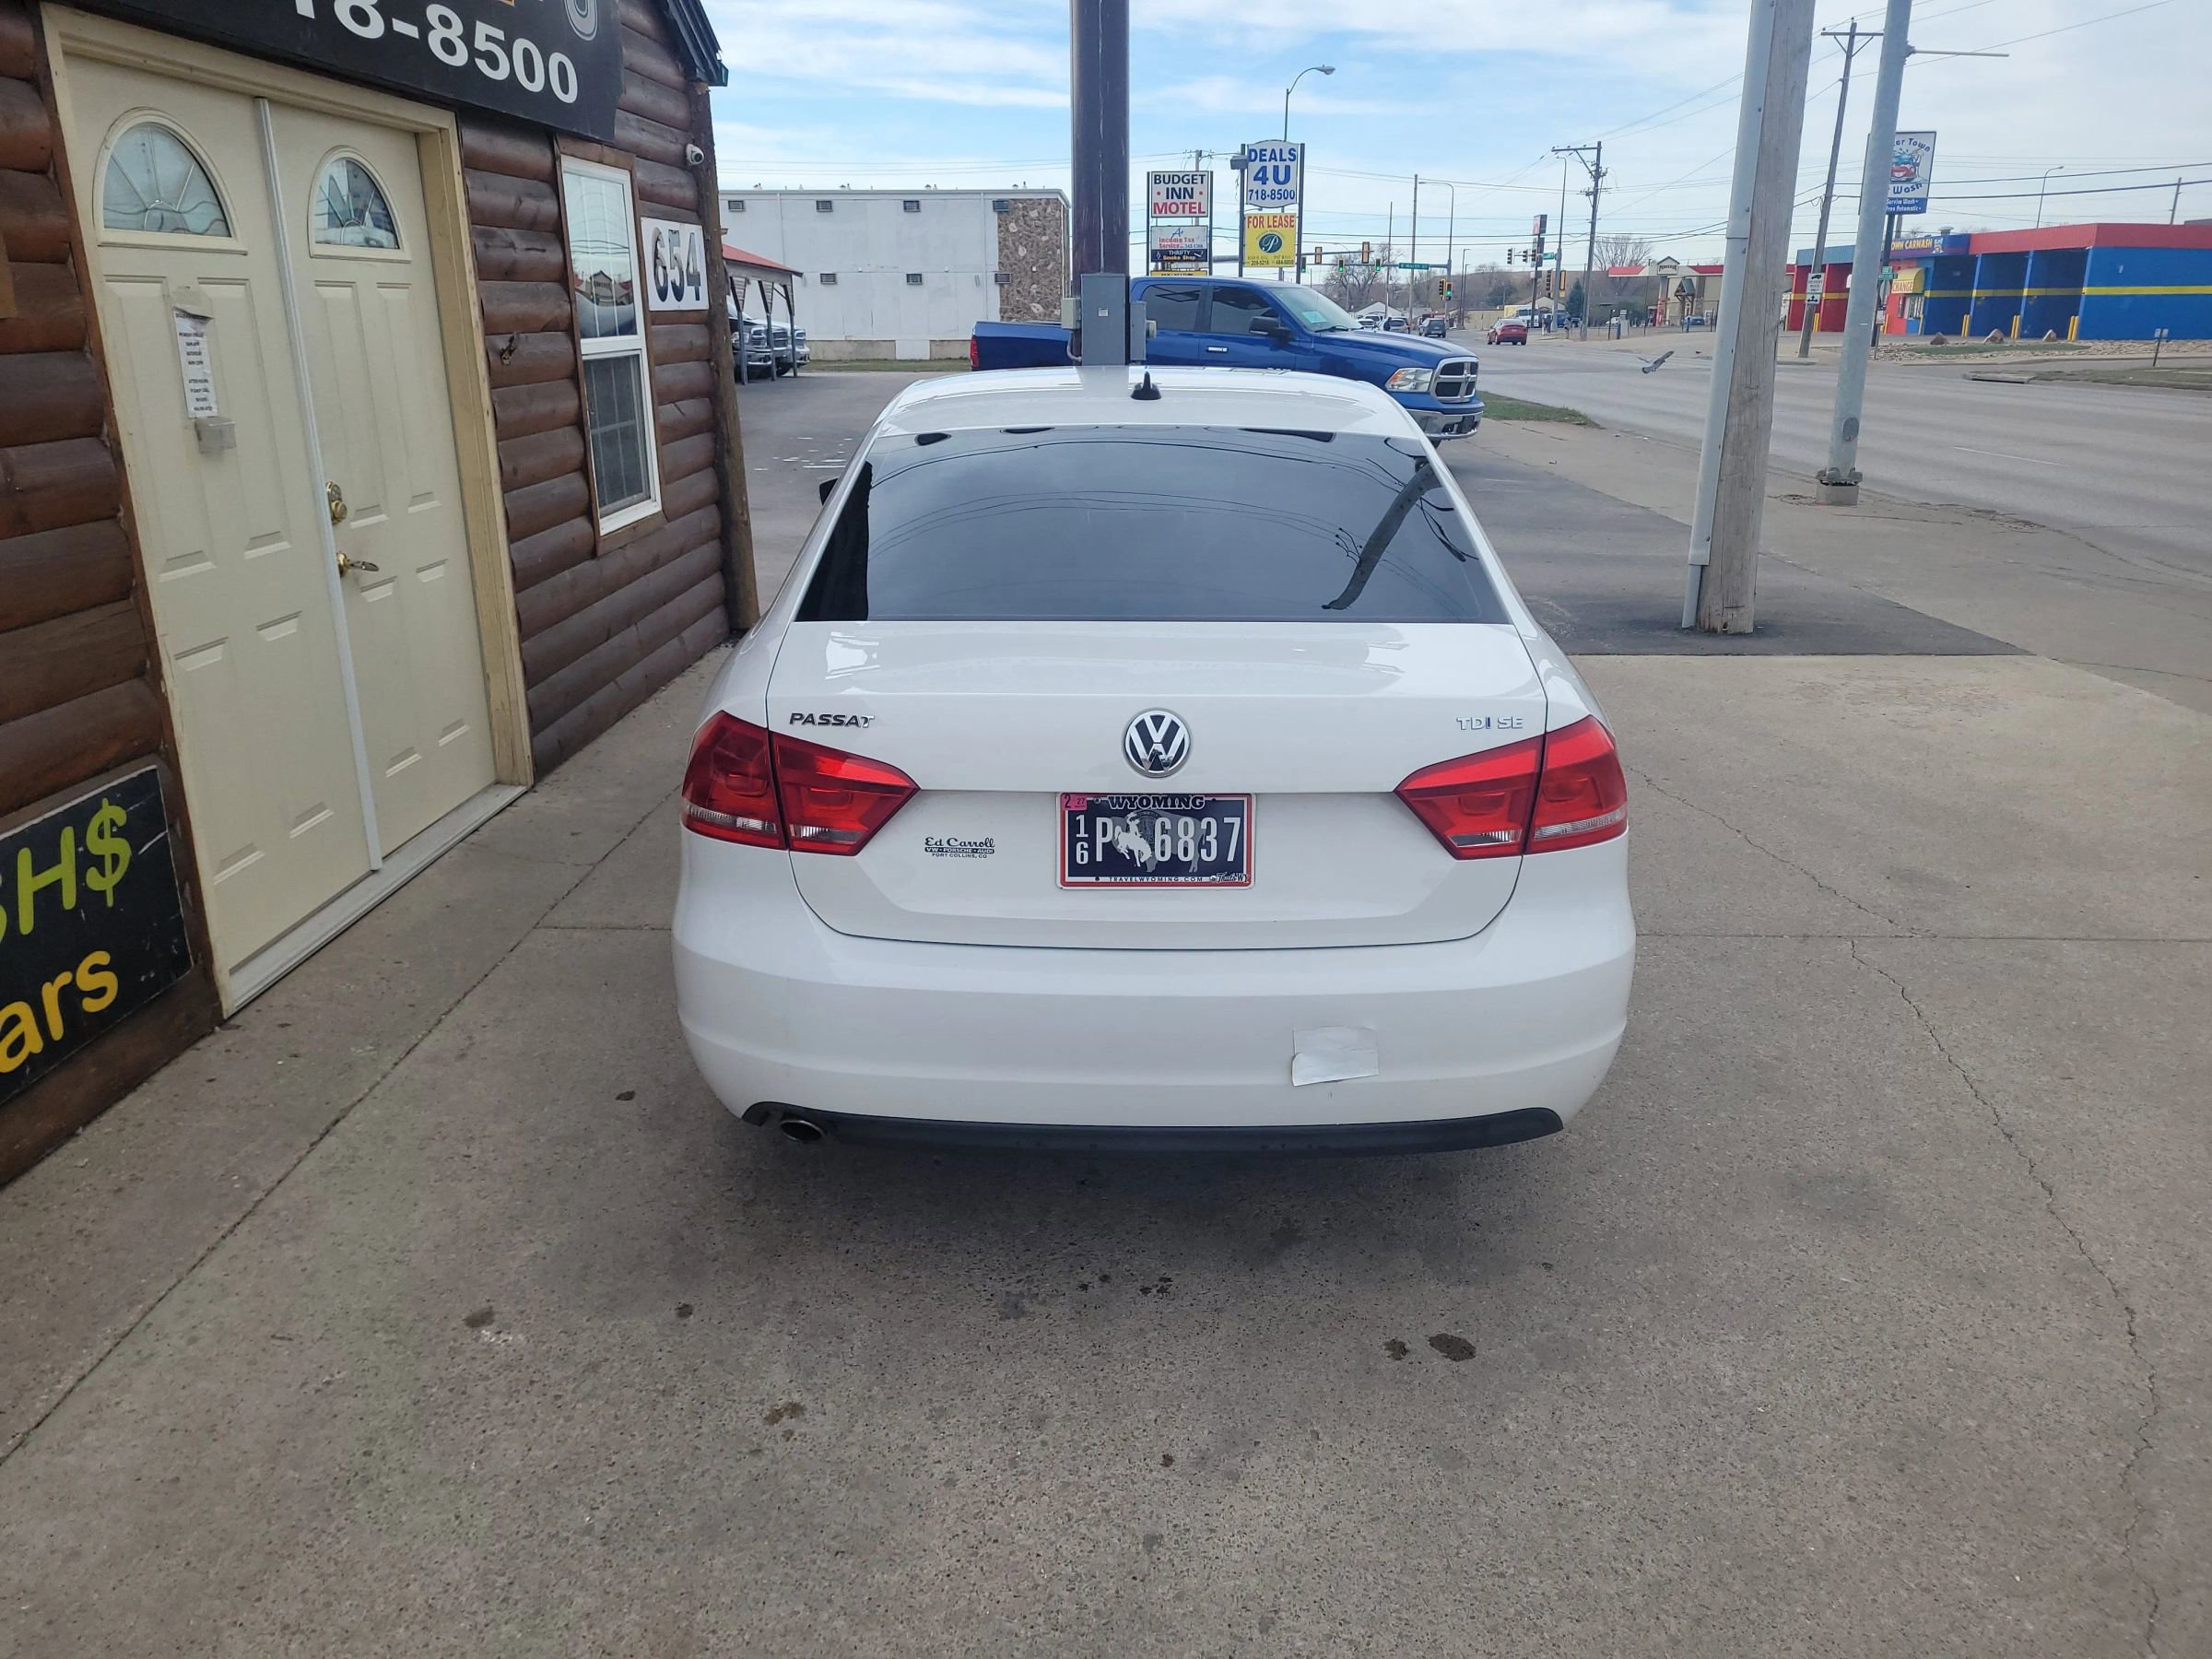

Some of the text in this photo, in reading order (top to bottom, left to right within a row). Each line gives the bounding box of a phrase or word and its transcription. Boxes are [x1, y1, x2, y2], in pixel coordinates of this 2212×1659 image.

[296, 0, 578, 104] 8-8500
[1909, 137, 1931, 153] Town
[1248, 147, 1297, 162] DEALS
[1153, 173, 1206, 185] BUDGET
[1165, 186, 1194, 200] INN
[1892, 182, 1924, 194] Wash
[1153, 202, 1206, 215] MOTEL
[1247, 215, 1295, 229] FOR LEASE
[1890, 238, 1934, 252] OWN CARWASH
[651, 227, 701, 303] 654
[1892, 280, 1913, 293] CHANGE
[789, 712, 876, 729] PASSAT
[1456, 716, 1524, 731] TDI SE
[1107, 794, 1206, 810] WYOMING
[924, 836, 995, 848] Ed Carroll
[1095, 817, 1241, 862] P 6837
